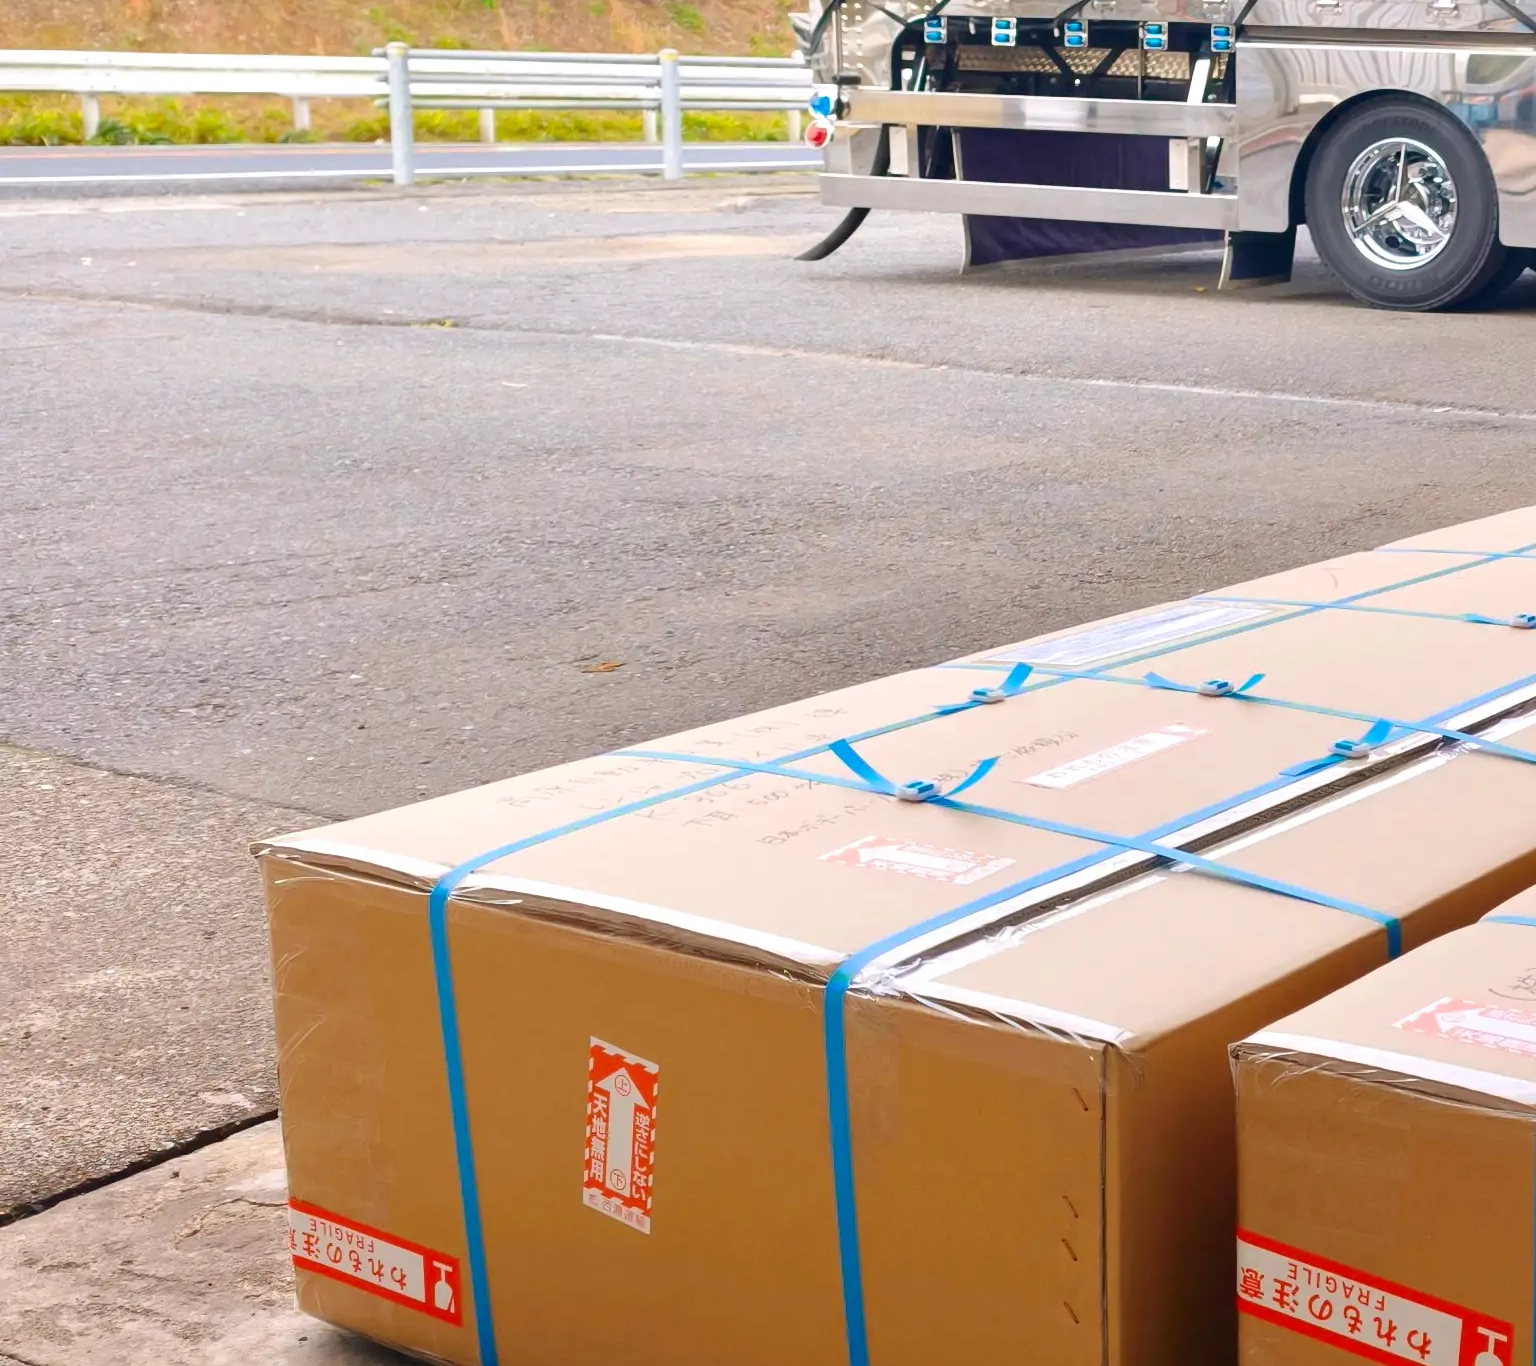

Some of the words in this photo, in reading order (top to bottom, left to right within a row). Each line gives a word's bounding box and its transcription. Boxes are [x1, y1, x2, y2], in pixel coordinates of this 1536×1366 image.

[589, 1092, 608, 1183] 天地無用
[309, 1218, 375, 1253] FRAGILE
[1240, 1266, 1432, 1360] われもの注意
[1286, 1262, 1386, 1312] FRAGILE
